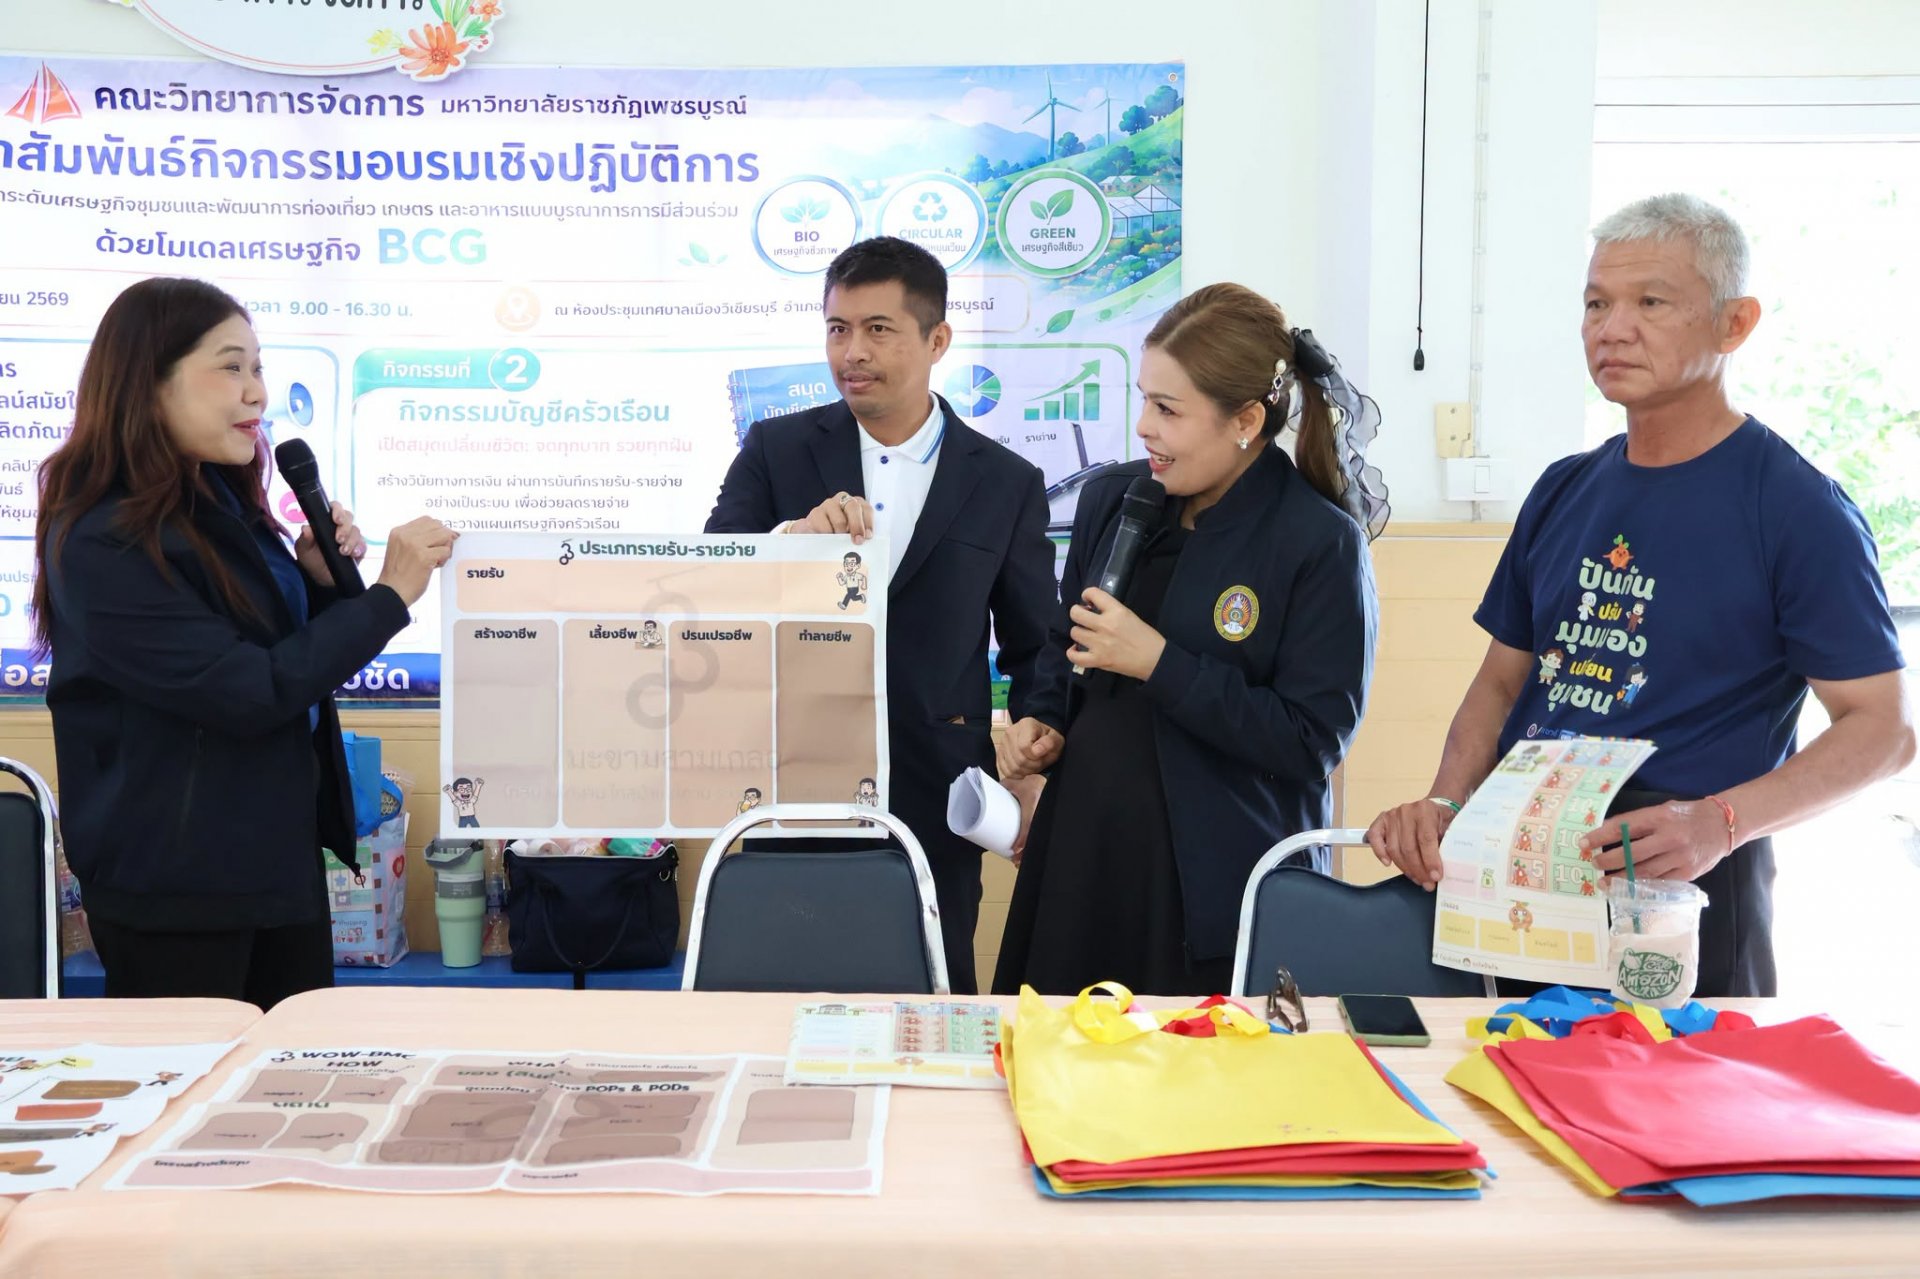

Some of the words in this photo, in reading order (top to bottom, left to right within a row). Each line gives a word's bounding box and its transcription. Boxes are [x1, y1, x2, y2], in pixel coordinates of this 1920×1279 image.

[95, 82, 425, 117] คณะวิทยาการจัดการ
[441, 94, 748, 121] มหาวิทยาลัยราชภัฏเพชรบูรณ์
[382, 203, 433, 216] เกษตร
[794, 231, 820, 242] BIO
[899, 228, 963, 239] CIRCULAR
[1030, 228, 1076, 239] GREEN
[96, 229, 361, 267] ด้วยโมเดลเศรษฐกิจ
[378, 228, 487, 265] BCG
[1021, 241, 1084, 255] เศรษฐกิจสีเขียว
[27, 291, 69, 306] 2569
[290, 301, 328, 315] 9.00
[345, 302, 391, 316] 16.30
[555, 307, 568, 316] ณ
[946, 298, 994, 314] ชรบูรณ์
[383, 357, 471, 379] กิจกรรมที่
[504, 355, 528, 384] 2
[788, 382, 827, 400] สมุด
[399, 399, 670, 427] กิจกรรมบัญชีครัวเรือน
[443, 517, 620, 532] ละวางแผนเศรษฐกิจครัวเรือน
[579, 540, 756, 557] ประเภทรายรับ-รายจ่าย
[466, 567, 505, 579] รายรับ
[1578, 557, 1656, 601] ปันกัน
[474, 627, 537, 640] สร้างอาชีพ
[589, 624, 638, 640] เลี้ยงชีพ
[681, 629, 753, 641] ปรนเปรอชีพ
[799, 630, 852, 643] ทำลายชีพ
[1532, 859, 1544, 878] 5
[1555, 864, 1584, 884] 10
[327, 1060, 382, 1068] HOW
[585, 1085, 625, 1093] POPs
[631, 1084, 642, 1092] &
[649, 1083, 690, 1092] PODs
